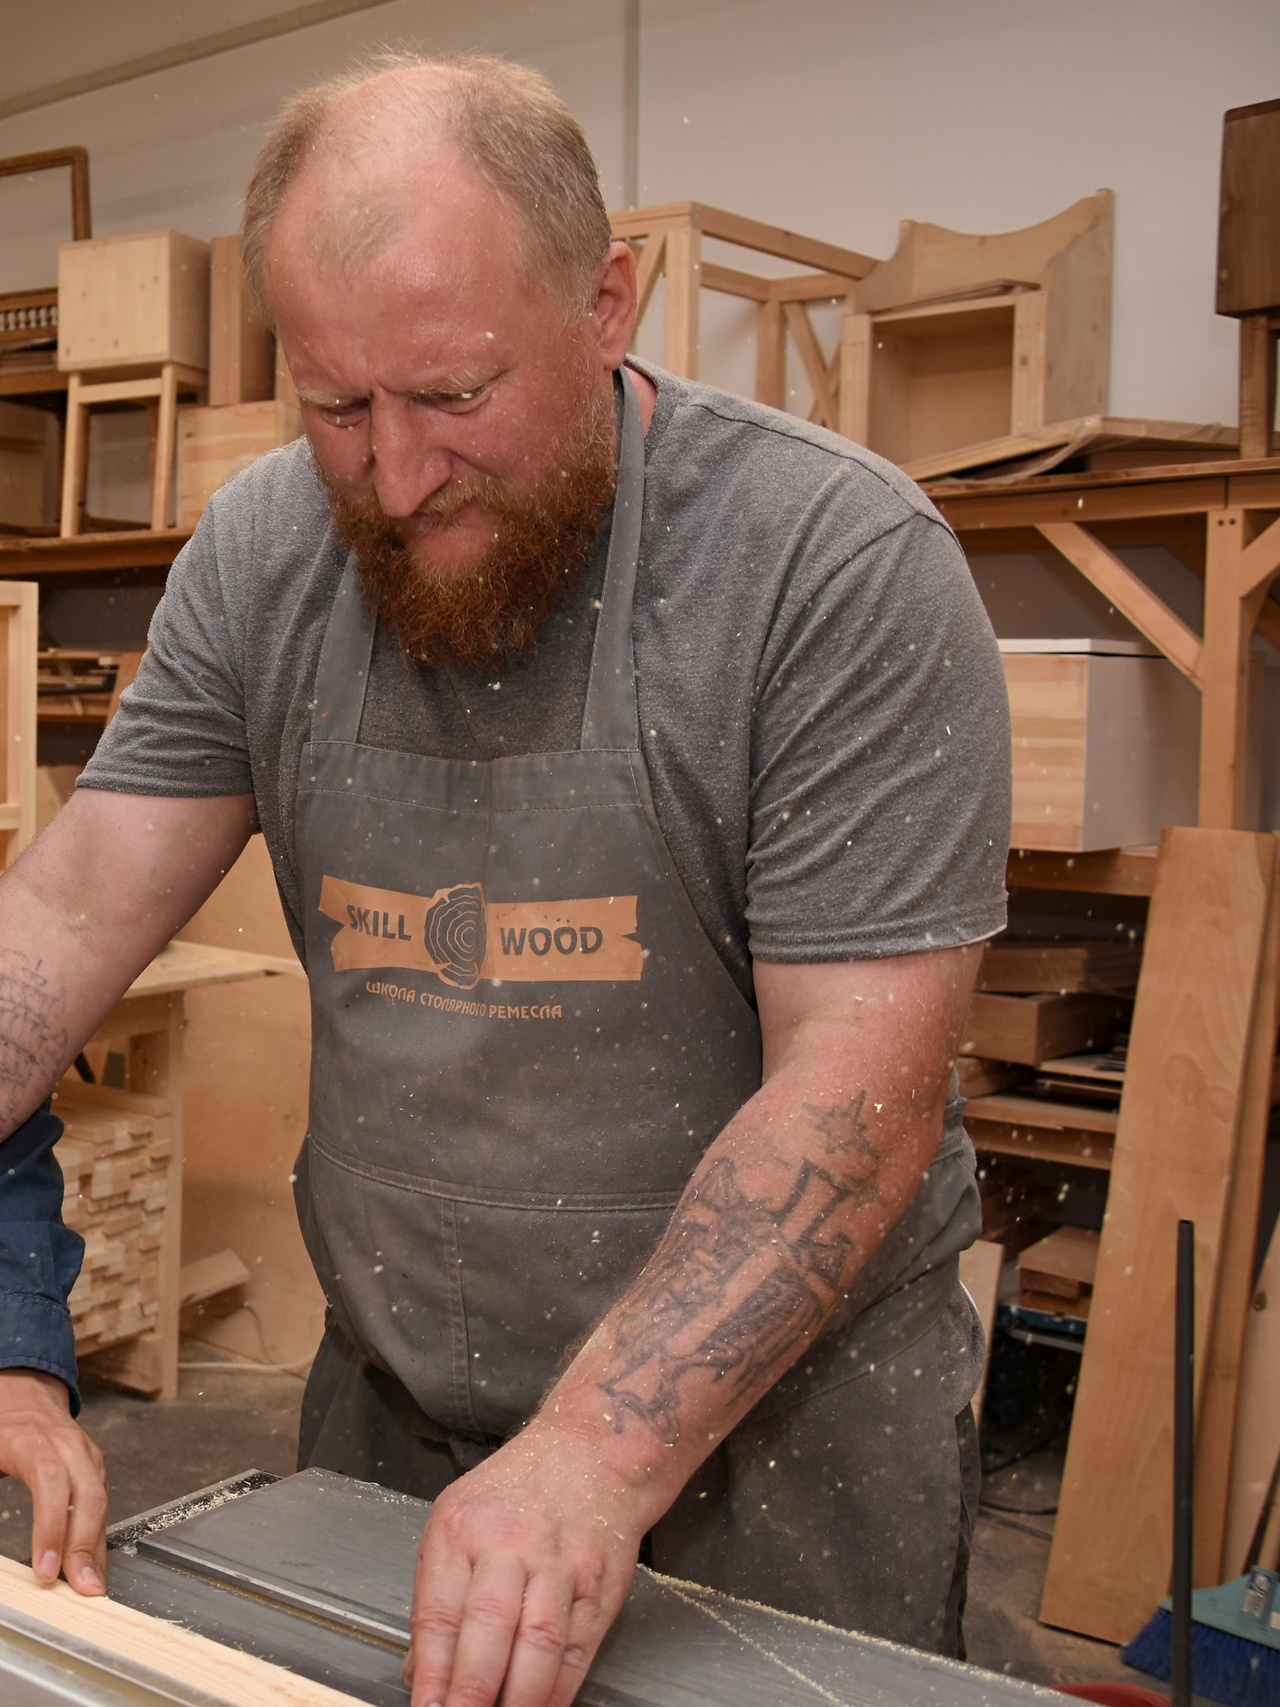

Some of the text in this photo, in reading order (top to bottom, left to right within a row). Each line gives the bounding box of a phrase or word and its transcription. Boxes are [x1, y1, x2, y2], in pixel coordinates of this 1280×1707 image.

[346, 904, 604, 956] SKILL WOOD
[365, 981, 563, 1019] ШКОЛА СТОЛЯРНОГО РЕМЕСЛА
